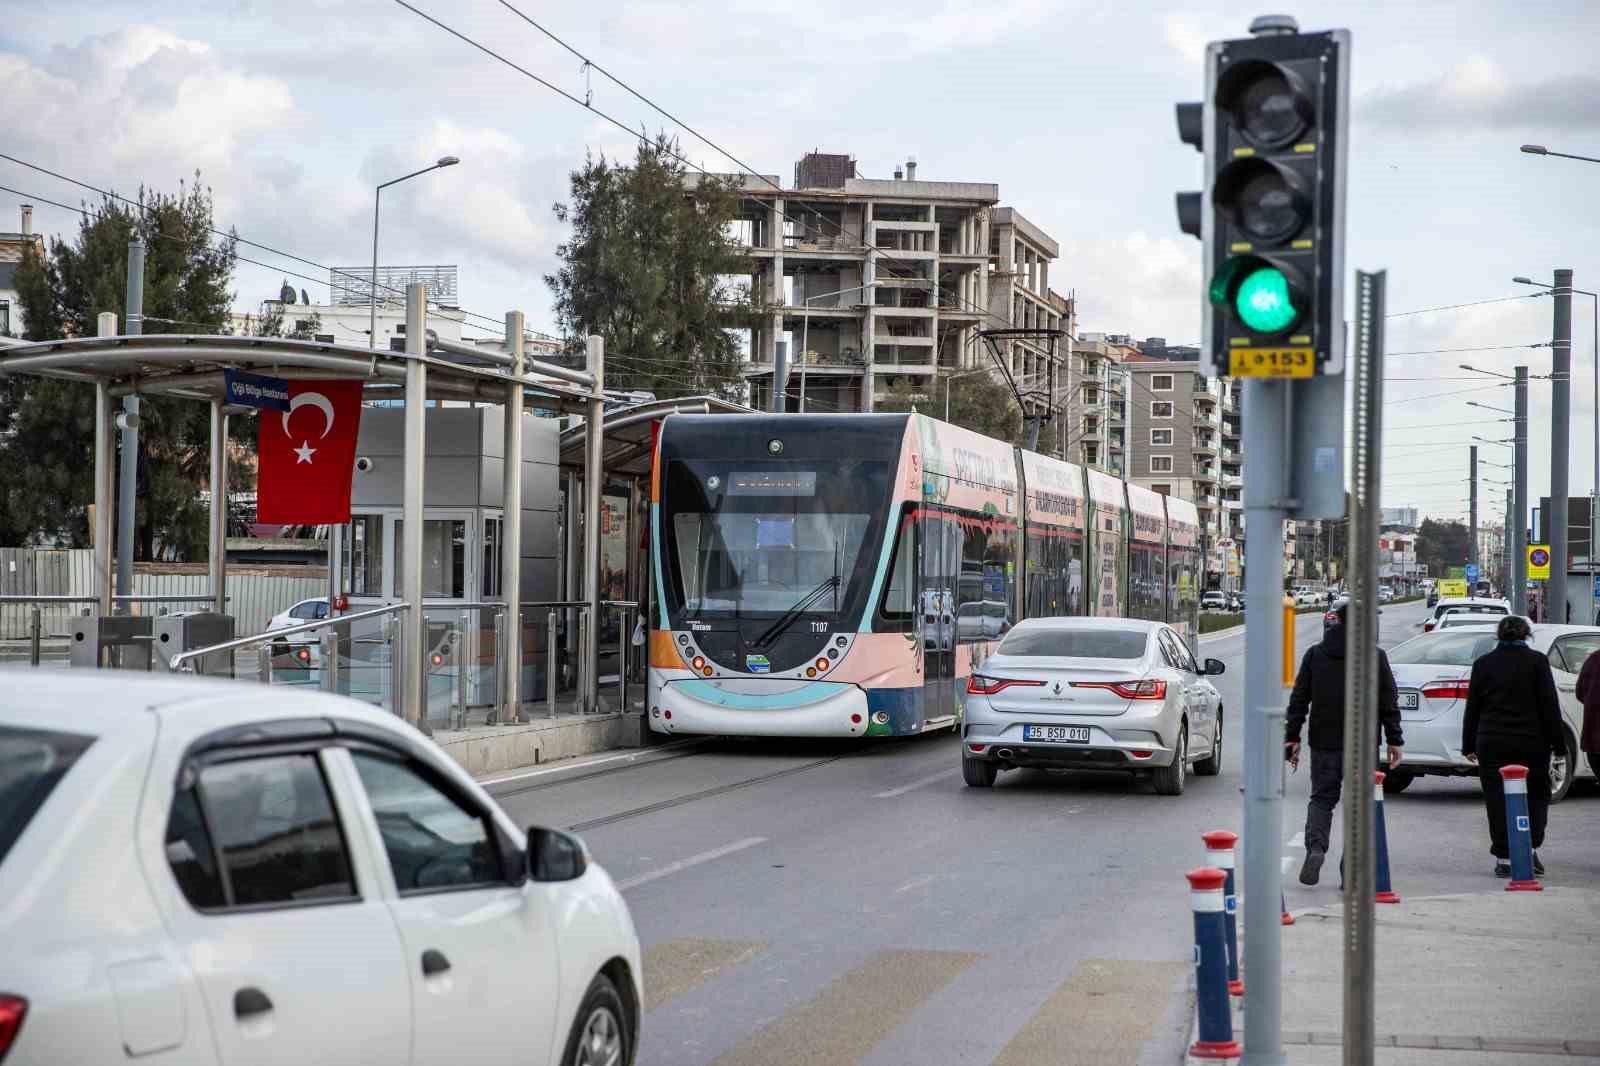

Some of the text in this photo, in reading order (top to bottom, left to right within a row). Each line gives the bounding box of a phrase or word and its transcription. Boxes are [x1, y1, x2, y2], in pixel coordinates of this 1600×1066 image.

[810, 622, 828, 633] T107
[1030, 727, 1088, 740] 35 BSD 010
